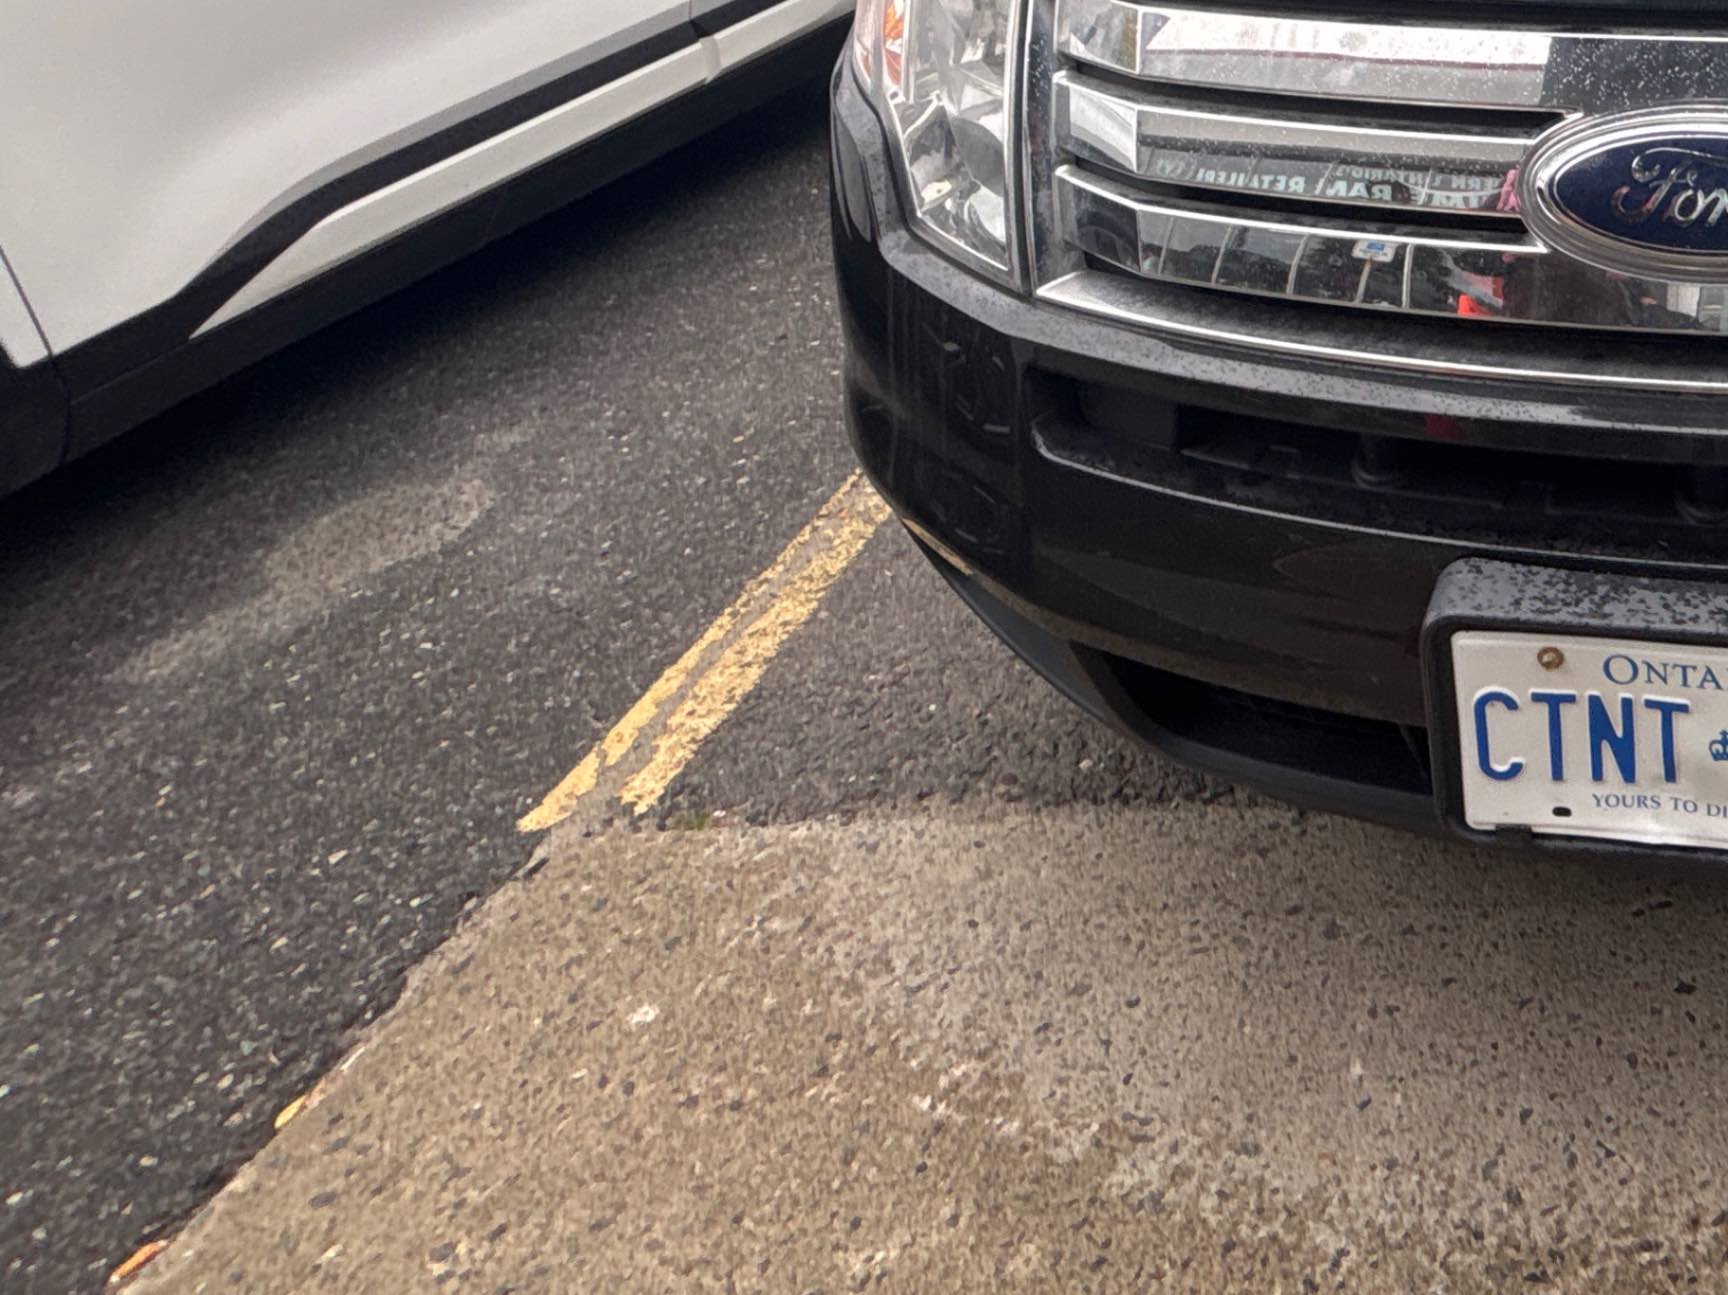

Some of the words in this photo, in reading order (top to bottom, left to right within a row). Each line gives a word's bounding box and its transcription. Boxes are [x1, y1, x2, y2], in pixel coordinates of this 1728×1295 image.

[1473, 687, 1691, 784] CTNT
[1592, 792, 1662, 811] YOURS
[1669, 796, 1698, 814] TO
